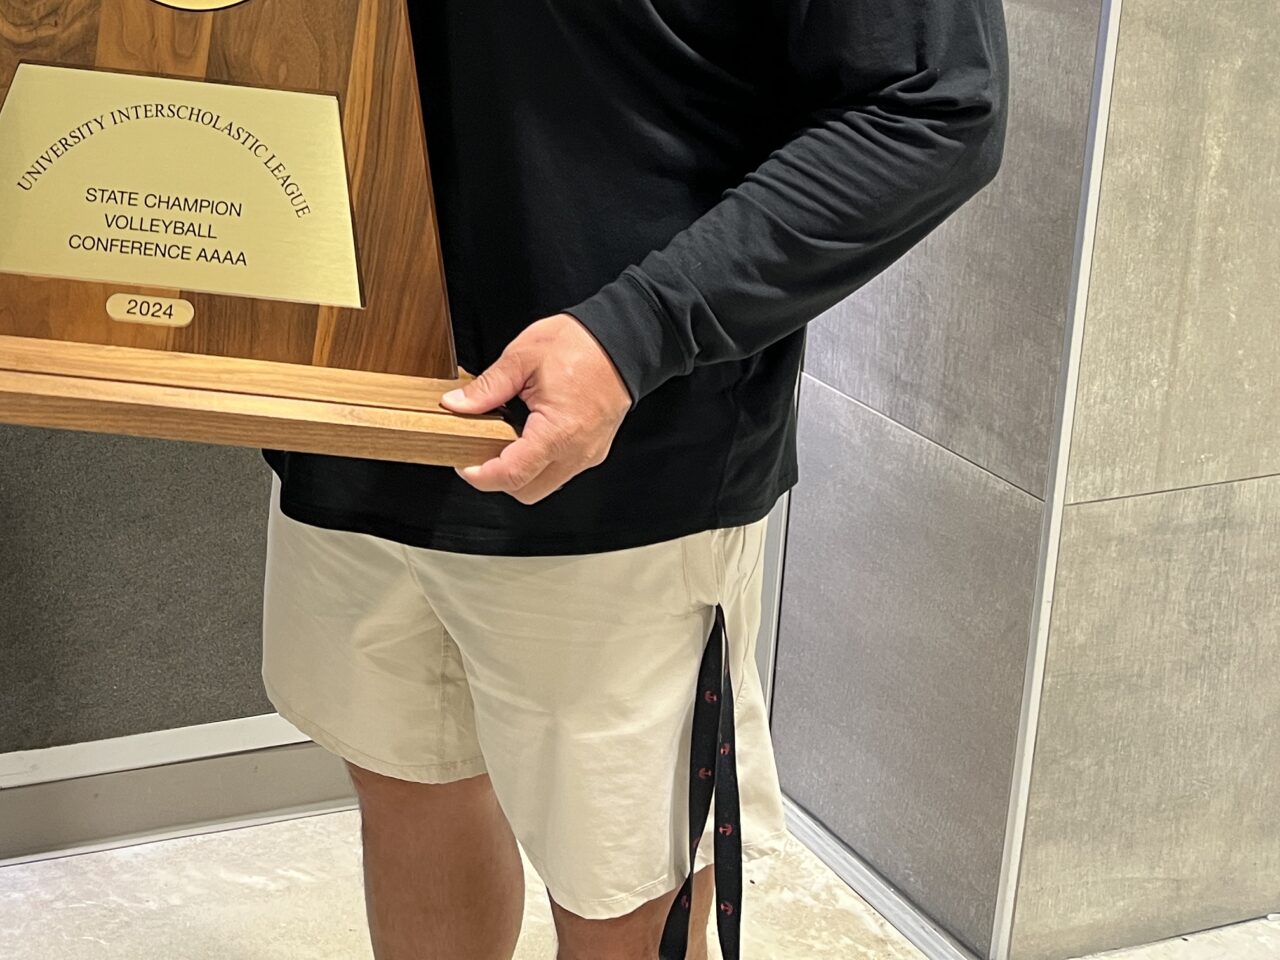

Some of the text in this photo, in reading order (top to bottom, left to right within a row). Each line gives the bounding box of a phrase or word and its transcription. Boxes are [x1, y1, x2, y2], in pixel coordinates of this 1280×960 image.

[17, 103, 311, 218] UNIVERSITY INTERSCHOLASTIC LEAGUE
[85, 187, 242, 217] STATE CHAMPION
[104, 213, 218, 239] VOLLEYBALL
[68, 234, 247, 266] CONFERENCE AAAA
[126, 298, 173, 319] 2024
